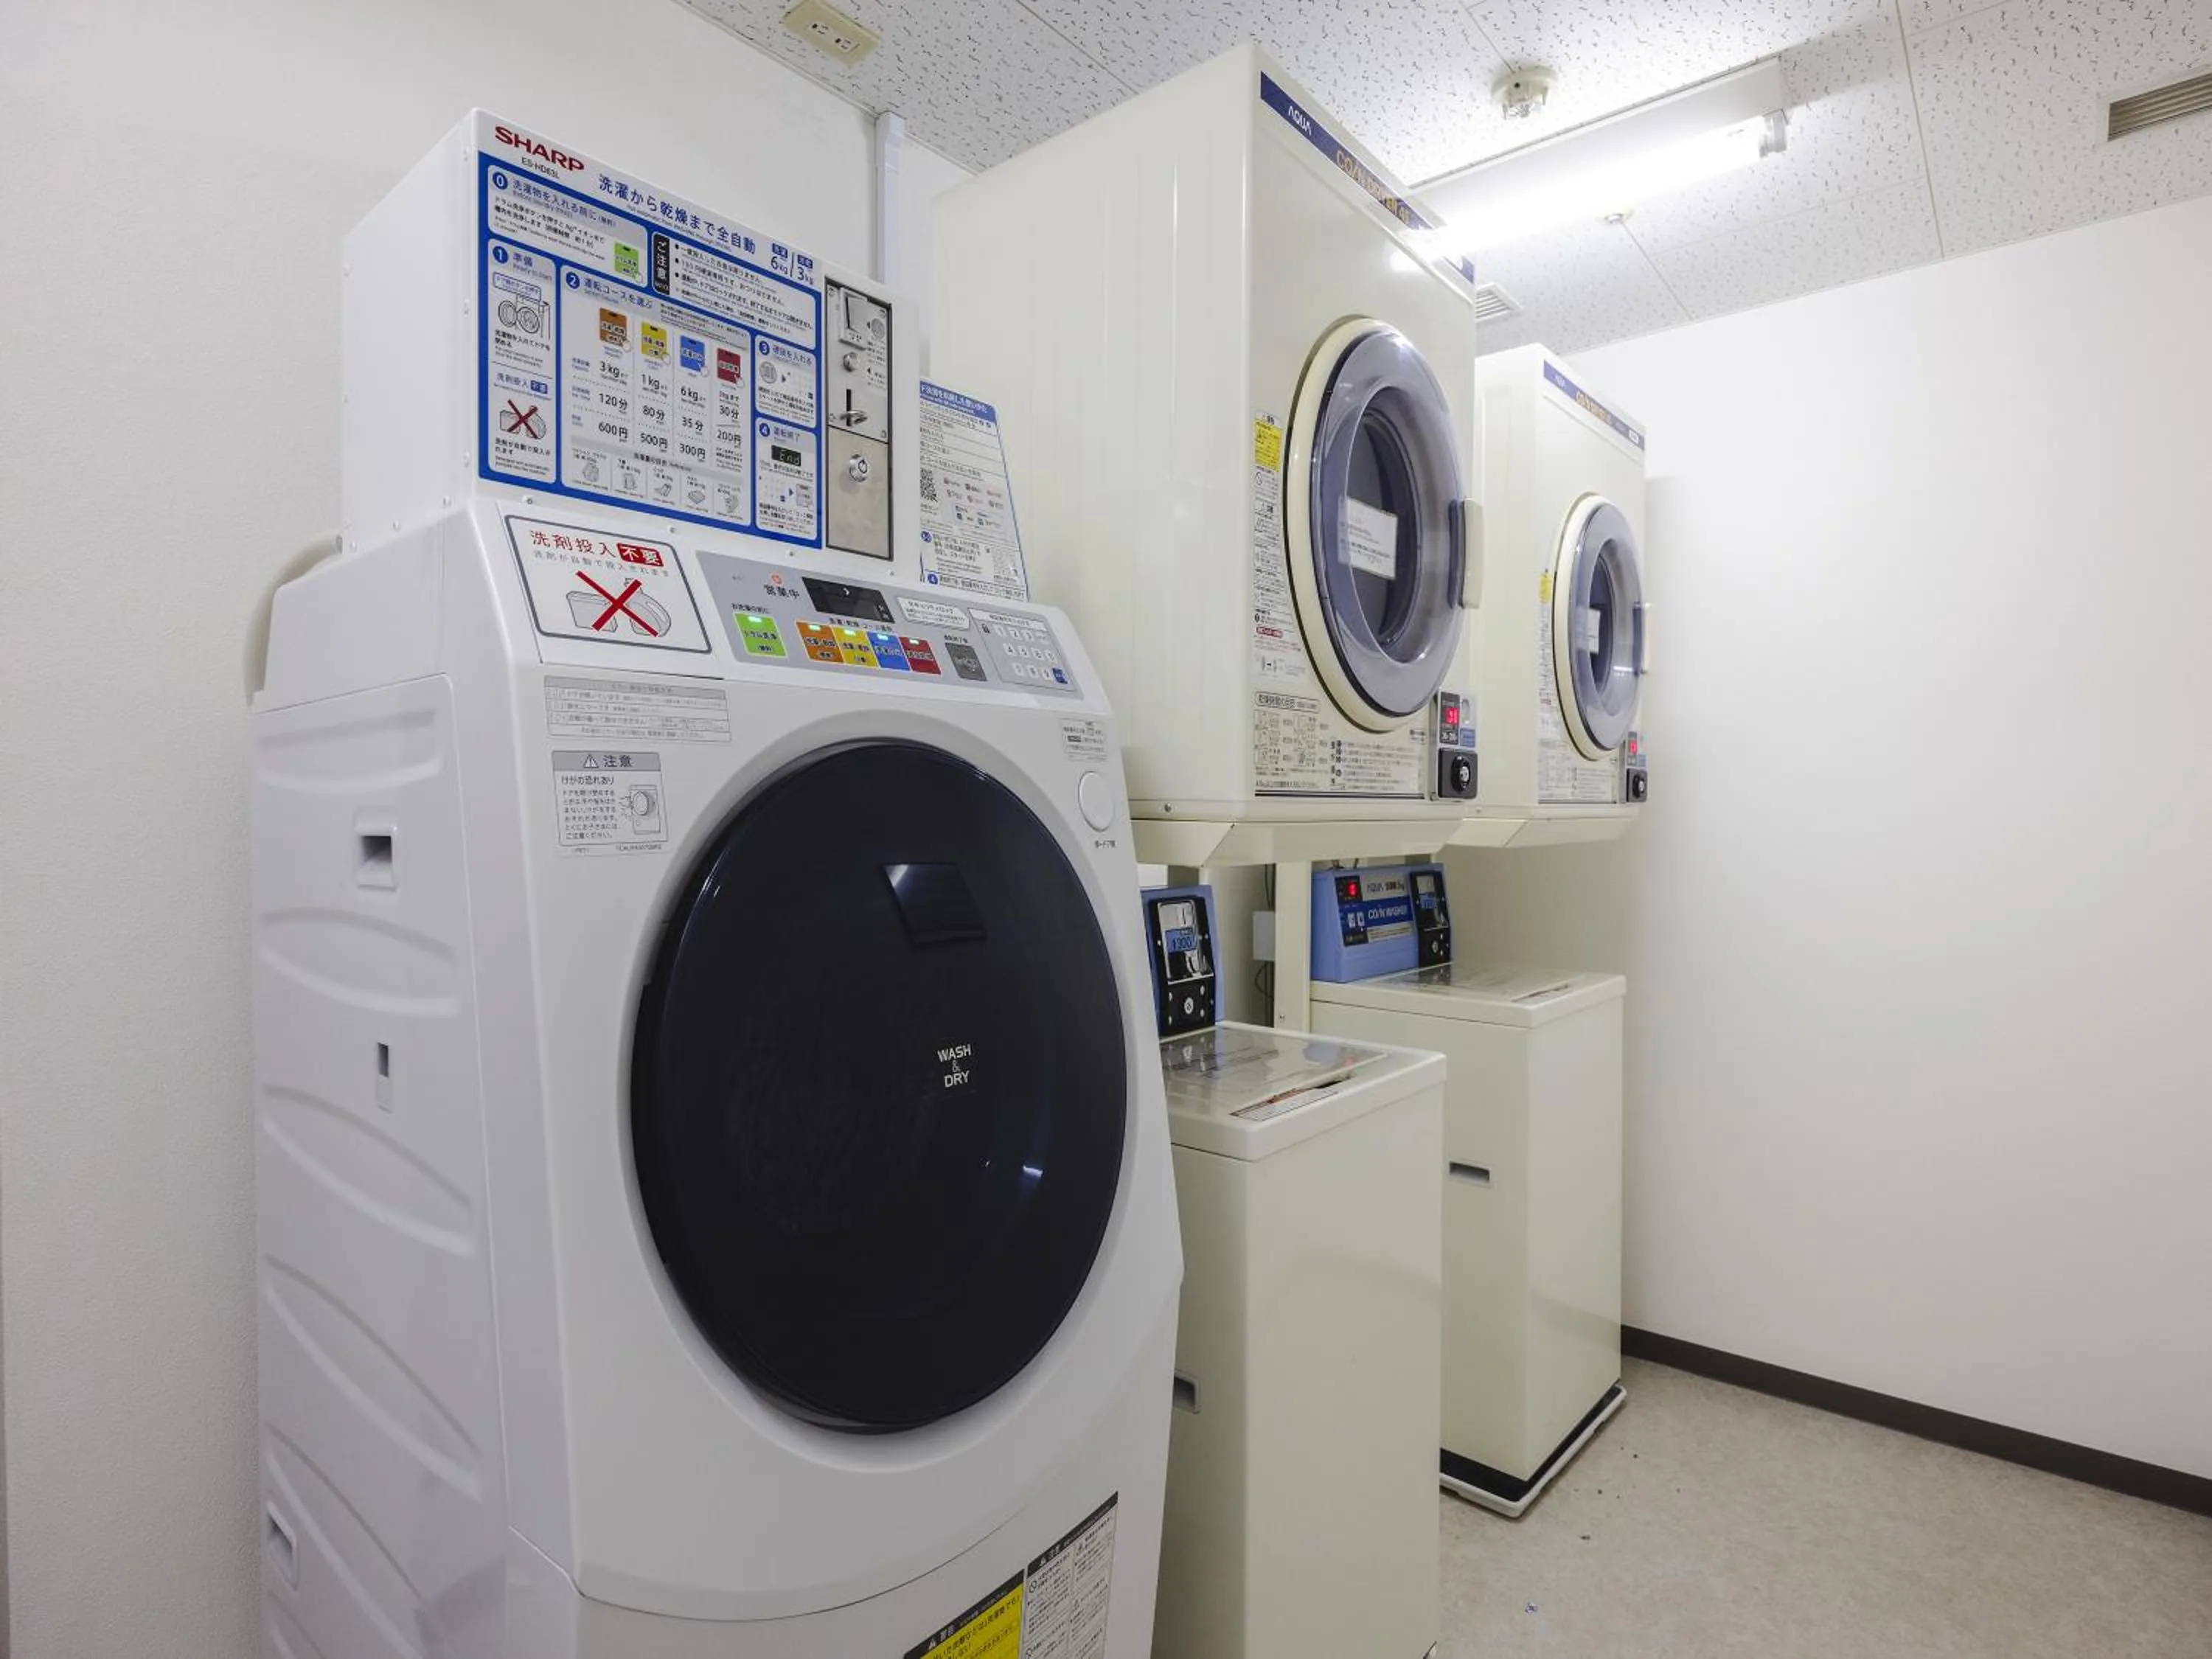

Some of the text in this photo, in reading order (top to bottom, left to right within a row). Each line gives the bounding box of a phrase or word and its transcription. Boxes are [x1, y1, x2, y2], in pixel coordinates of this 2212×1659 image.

[495, 125, 585, 172] SHARP
[598, 173, 756, 254] 洗濯から乾燥まで全自動
[599, 392, 627, 411] 120分
[642, 405, 665, 421] 80分
[719, 404, 740, 420] 30分
[598, 421, 628, 439] 600円
[681, 416, 704, 432] 35分
[640, 432, 669, 450] 500円
[717, 429, 742, 445] 200円
[679, 442, 706, 459] 300円
[531, 529, 662, 566] 洗剤投入 不要
[603, 754, 633, 768] 注意
[937, 1043, 972, 1062] WASH
[952, 1060, 961, 1073] &
[944, 1071, 970, 1088] DRY
